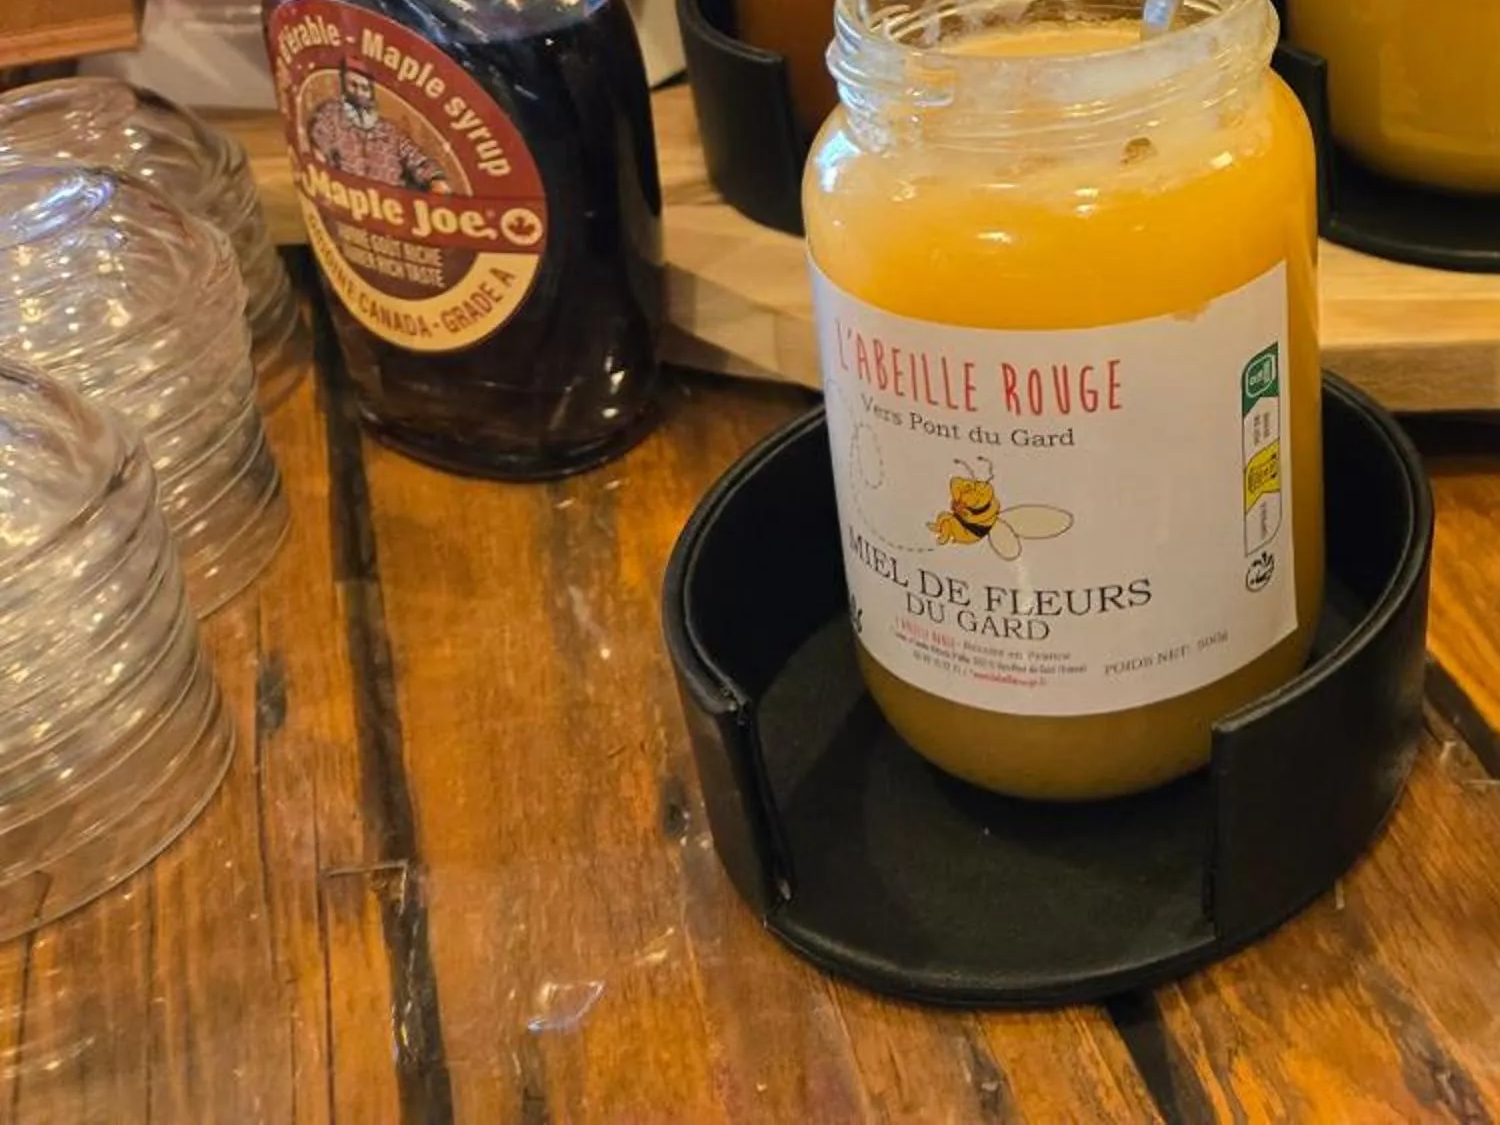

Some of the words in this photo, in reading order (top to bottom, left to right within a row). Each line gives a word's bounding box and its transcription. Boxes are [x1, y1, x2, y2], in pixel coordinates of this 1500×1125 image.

[361, 29, 447, 99] Maple
[444, 95, 512, 178] syrup
[303, 165, 406, 226] Maple
[411, 199, 499, 241] Joe
[358, 290, 433, 339] CANADA
[440, 282, 503, 334] GRADE
[489, 266, 515, 287] A
[836, 318, 979, 413] L'ABEILLE
[1001, 359, 1123, 417] ROUGE
[859, 392, 903, 426] Vers
[909, 412, 961, 441] Pont
[969, 425, 1001, 446] du
[1010, 428, 1076, 449] Gard
[850, 529, 909, 588] MIEL
[917, 568, 971, 607] DE
[983, 578, 1152, 618] FLEURS
[905, 592, 946, 624] DU
[956, 608, 1050, 642] GARD
